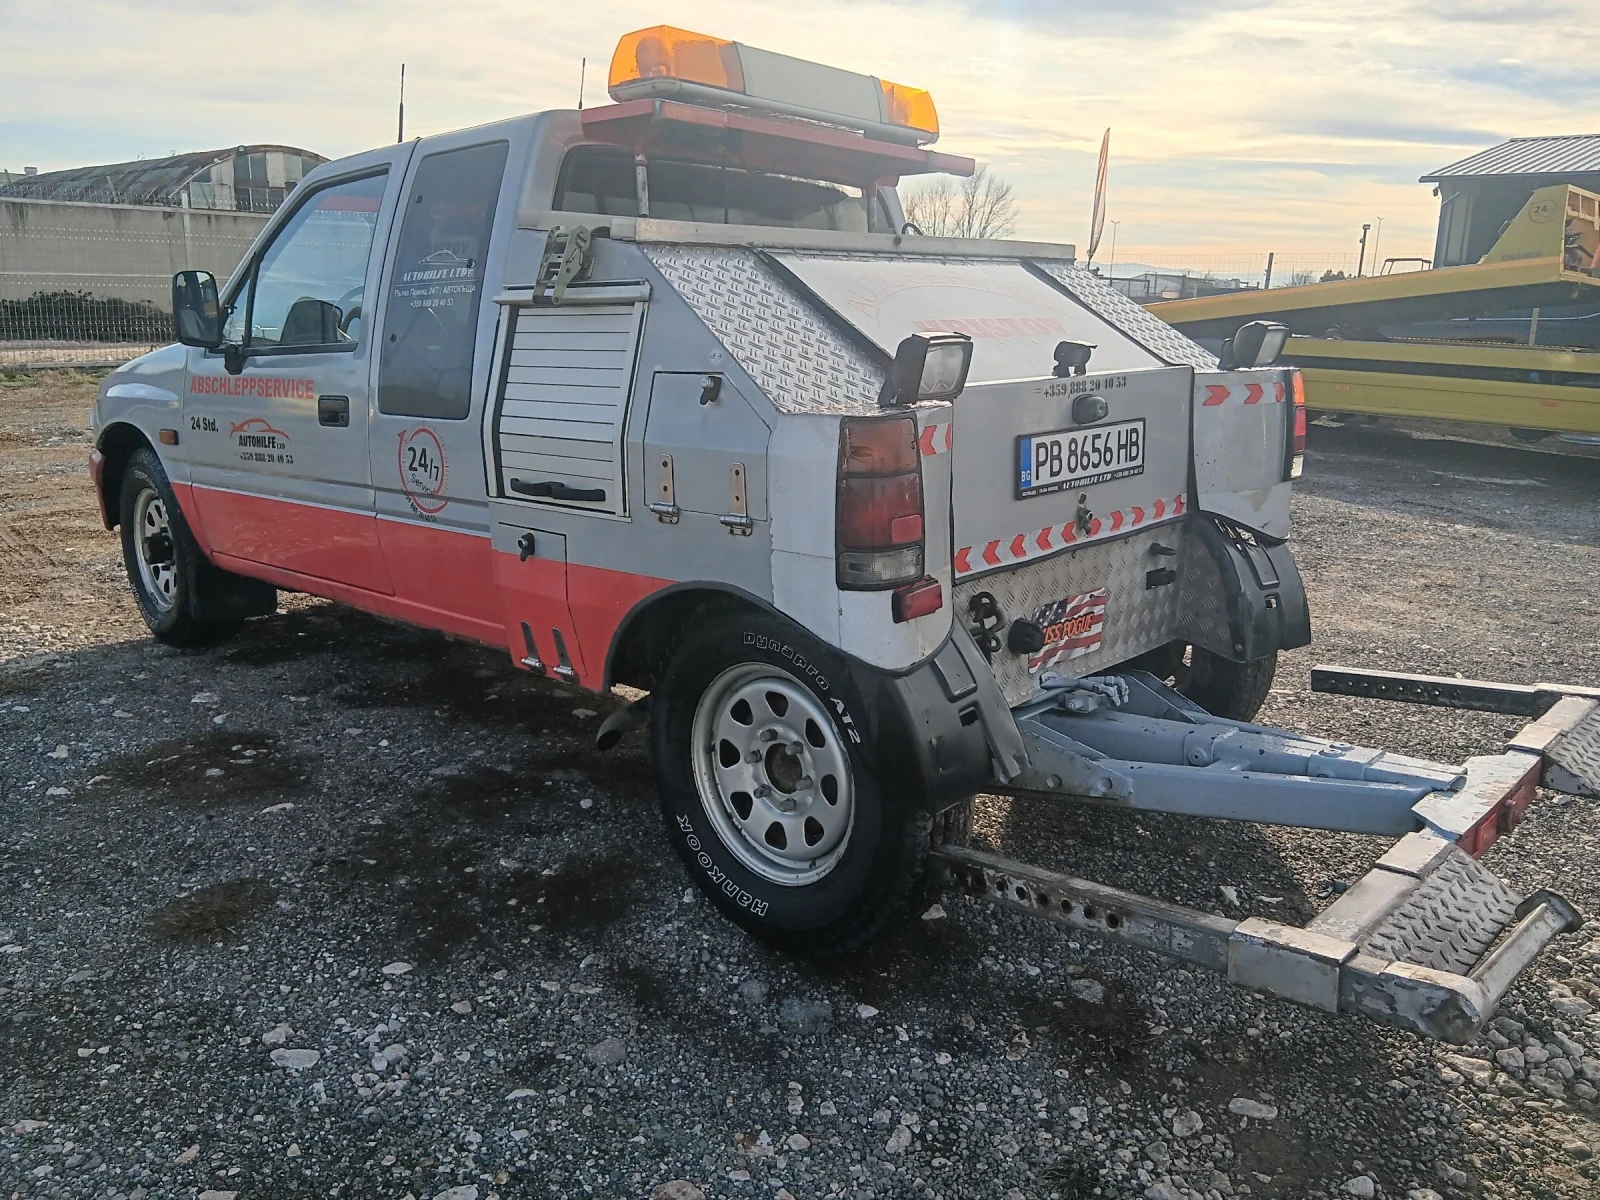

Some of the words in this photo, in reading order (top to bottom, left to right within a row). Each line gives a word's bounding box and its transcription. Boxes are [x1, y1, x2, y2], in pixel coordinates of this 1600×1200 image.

[449, 267, 468, 278] LTD
[190, 376, 314, 400] ABSCHLEPPSERVICE
[1089, 379, 1101, 392] 20
[1104, 377, 1114, 390] 40
[1116, 375, 1127, 388] 53
[191, 416, 201, 431] 24
[202, 417, 219, 432] Std.
[238, 434, 276, 449] AUTOHILFE
[267, 453, 275, 463] 20
[285, 454, 294, 465] 53
[407, 446, 440, 482] 24/7
[1035, 439, 1063, 481] PB
[1067, 431, 1114, 474] 8656
[1117, 427, 1140, 465] HB
[410, 473, 435, 496] Service
[1021, 470, 1031, 482] BG
[1062, 612, 1094, 640] POGUE
[742, 631, 830, 691] Dynapro
[830, 696, 861, 744] AT2
